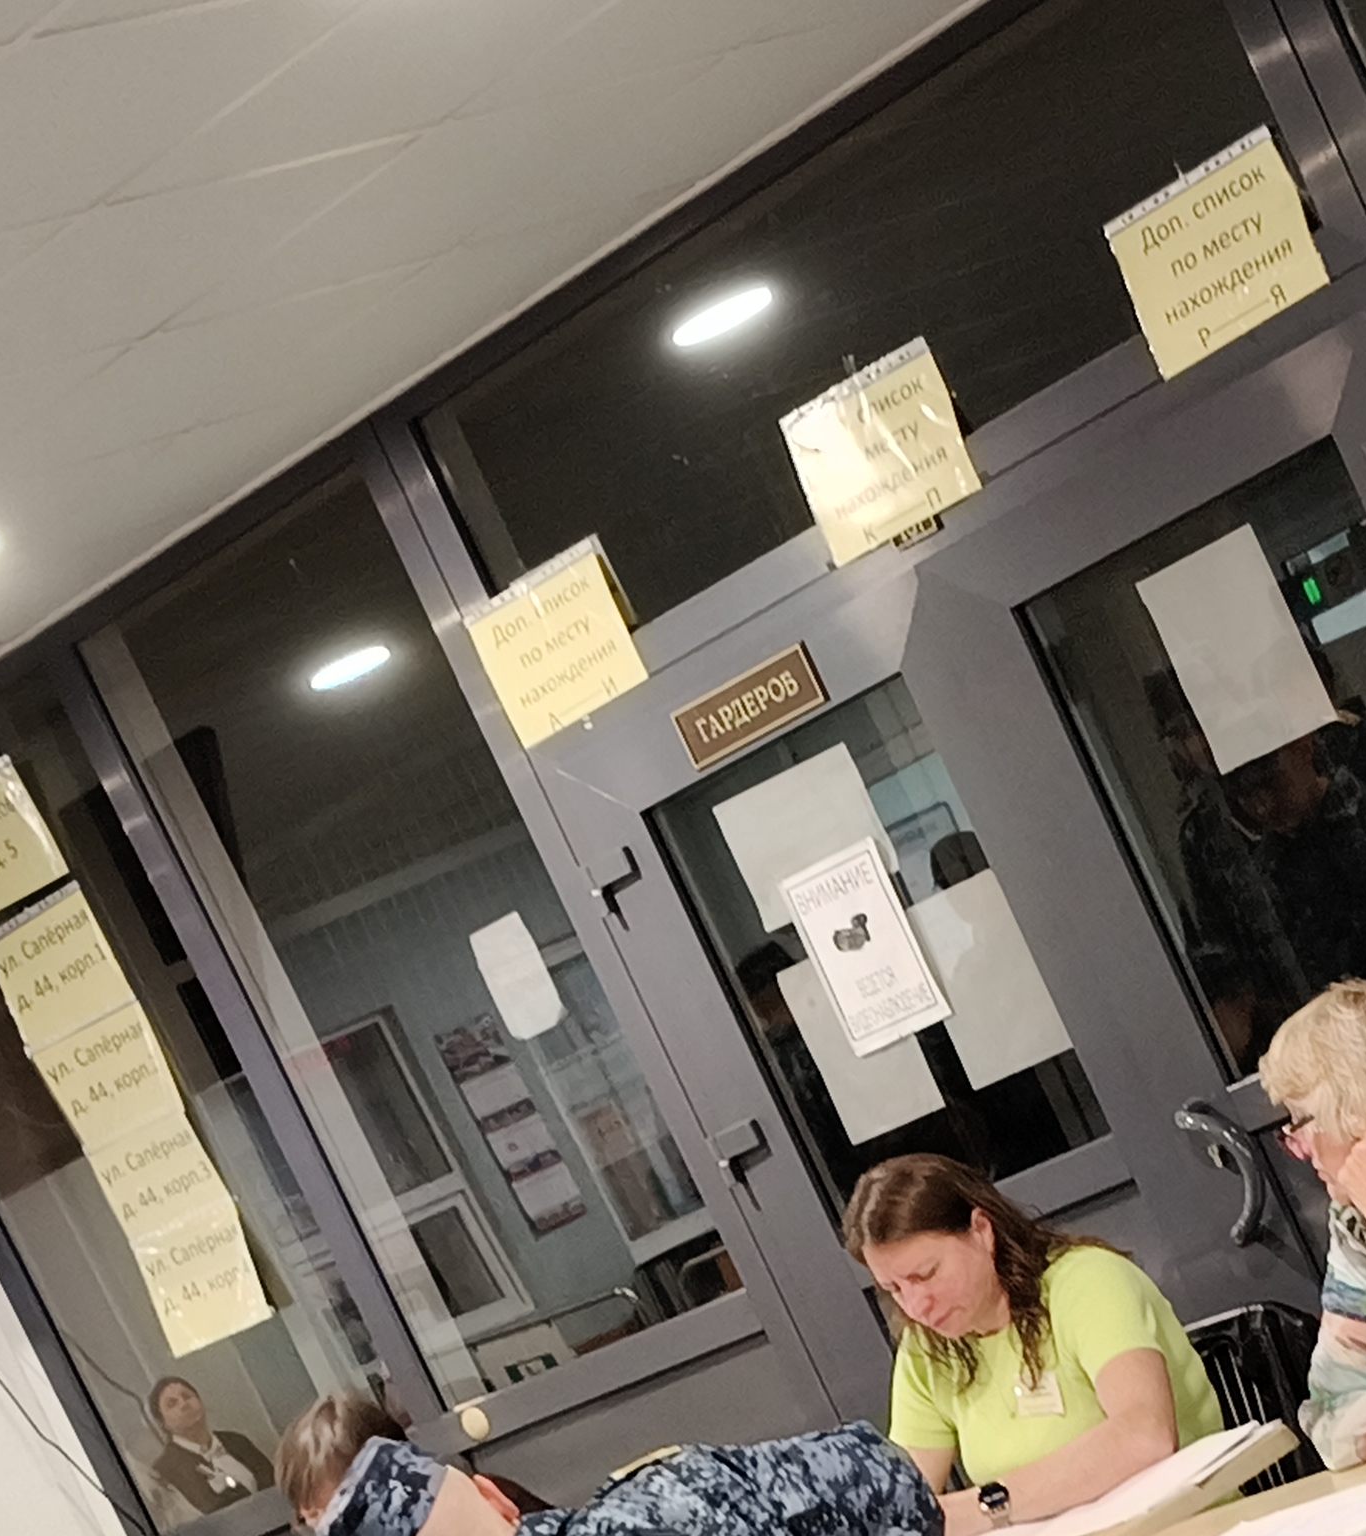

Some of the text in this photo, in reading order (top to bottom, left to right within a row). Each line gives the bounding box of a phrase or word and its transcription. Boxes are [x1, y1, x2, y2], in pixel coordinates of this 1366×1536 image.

[1138, 164, 1267, 257] Доп. список
[1169, 211, 1265, 278] по месту
[1163, 237, 1295, 326] нахождения
[834, 445, 950, 518] нахождения
[489, 613, 533, 650] Доп.
[518, 615, 592, 670] по месту
[518, 637, 619, 709] нахождения
[693, 669, 800, 745] ГАРДЕРОБ
[2, 837, 20, 860] 5
[794, 860, 874, 916] ВНИМАНИЕ
[19, 907, 91, 962] Сапёрная
[15, 941, 108, 1016] д. 44, корп.1
[45, 1059, 73, 1086] ул.
[69, 1096, 90, 1118] д.
[87, 1079, 115, 1104] 44,
[99, 1162, 125, 1189] ул.
[119, 1159, 214, 1223] д. 44, корп.3
[143, 1256, 169, 1281] ул.
[179, 1278, 208, 1304] 44,
